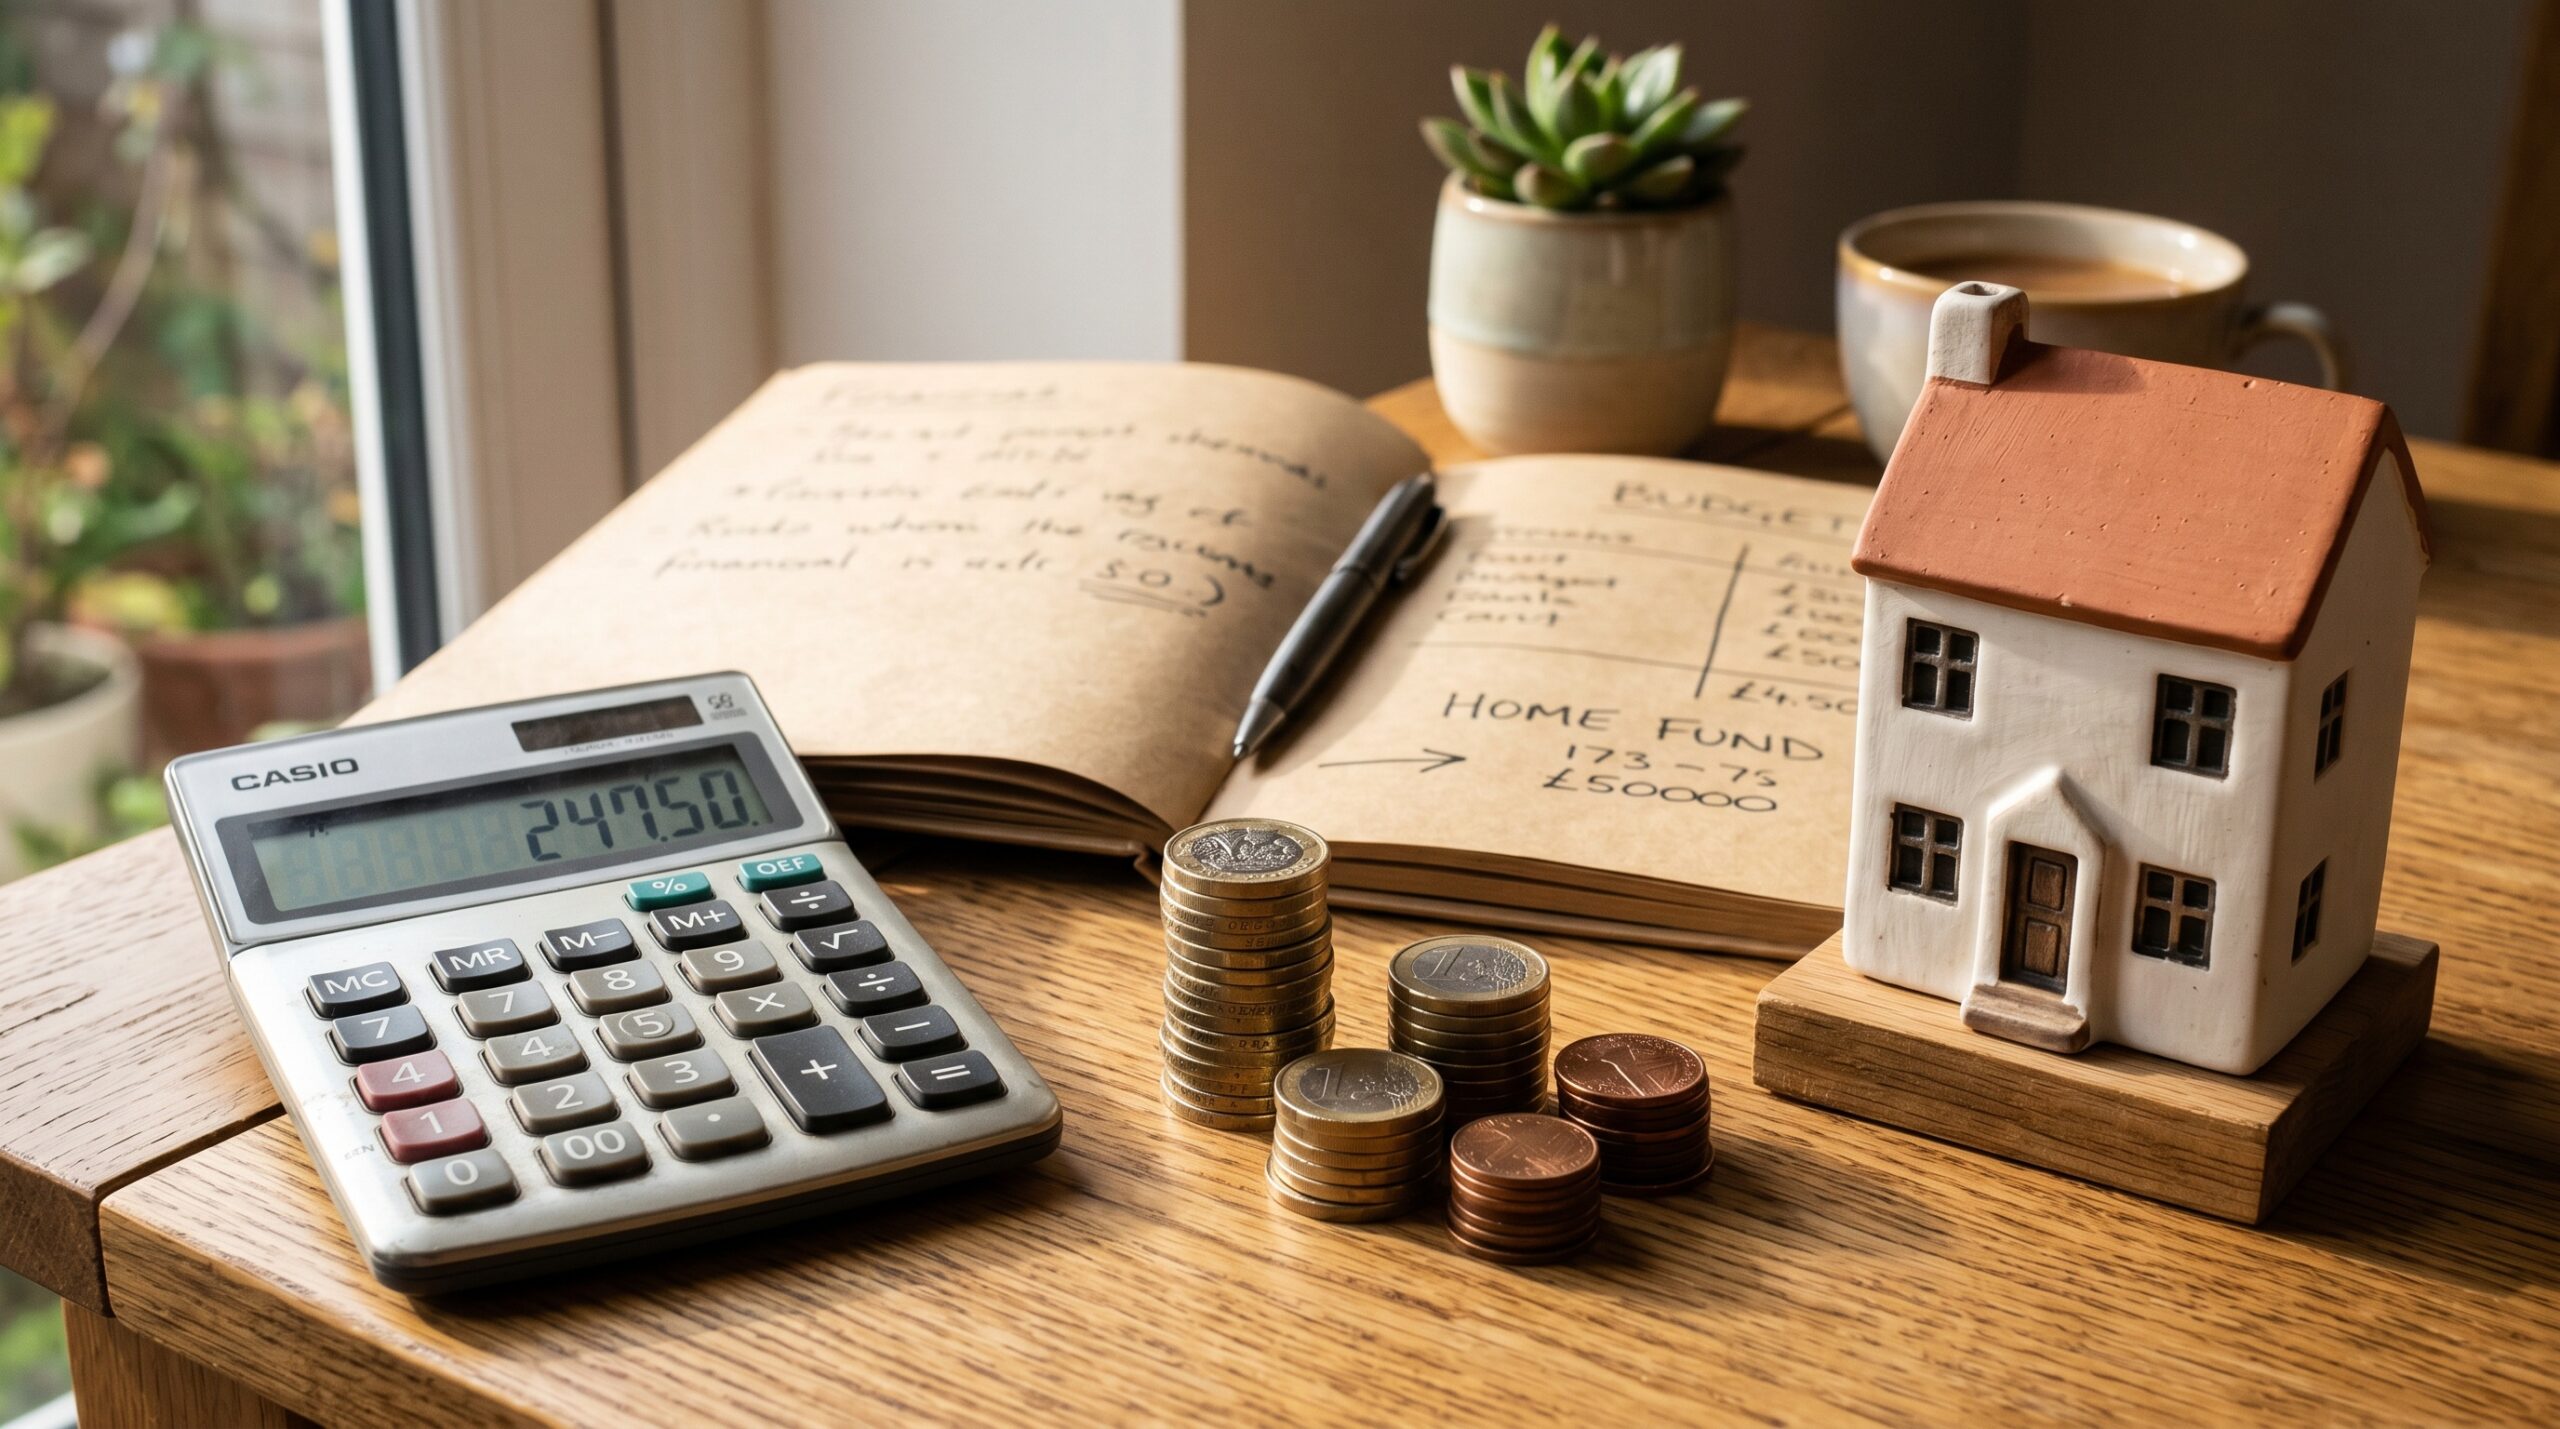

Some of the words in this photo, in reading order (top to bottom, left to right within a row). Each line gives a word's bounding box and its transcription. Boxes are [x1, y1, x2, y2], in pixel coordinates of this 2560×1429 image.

[1613, 482, 1856, 532] BUDGET
[1443, 692, 1620, 732] HOME
[1656, 717, 1824, 761] FUND
[1566, 744, 1651, 771] 173
[231, 758, 359, 791] CASIO
[1542, 767, 1778, 812] £50000
[668, 909, 726, 931] M+
[450, 947, 512, 971] MR
[713, 950, 745, 972] 9
[324, 970, 389, 995] MC
[602, 969, 636, 991] 8
[488, 990, 514, 1014] 7
[361, 1016, 390, 1040] 7
[632, 1012, 665, 1036] 5
[520, 1035, 554, 1058] 4
[391, 1061, 426, 1084] 4
[664, 1060, 699, 1084] 3
[547, 1084, 584, 1110] 2
[420, 1111, 443, 1134] 1
[563, 1128, 626, 1160] 00
[444, 1159, 479, 1186] 0
